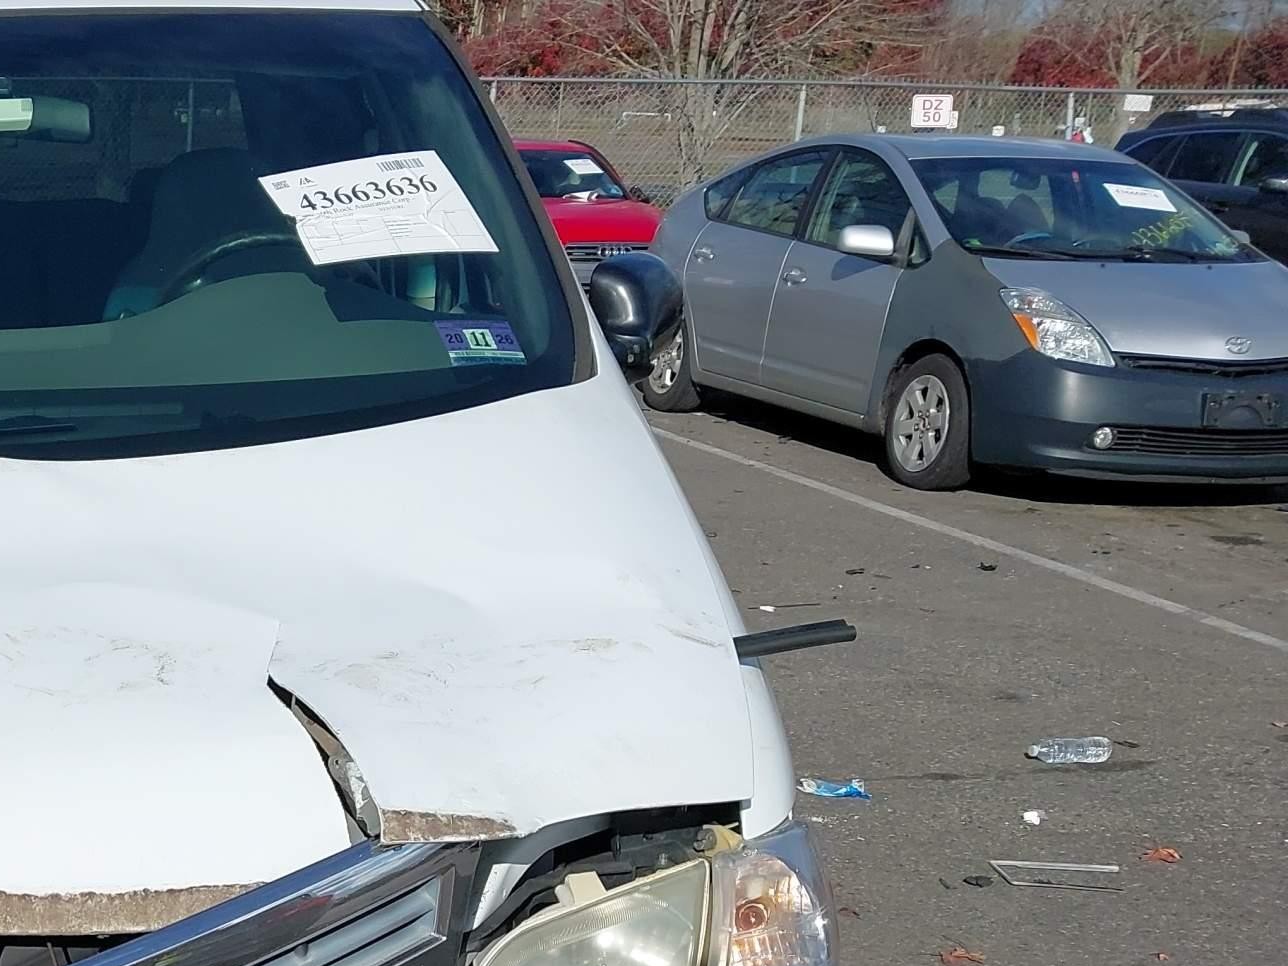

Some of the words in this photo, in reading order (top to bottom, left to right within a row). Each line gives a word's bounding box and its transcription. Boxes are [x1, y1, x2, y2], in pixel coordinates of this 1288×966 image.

[922, 99, 944, 111] DZ
[922, 111, 941, 122] 50
[300, 174, 438, 211] 43663636
[445, 333, 464, 344] 20
[469, 331, 492, 347] 11
[495, 334, 514, 345] 26
